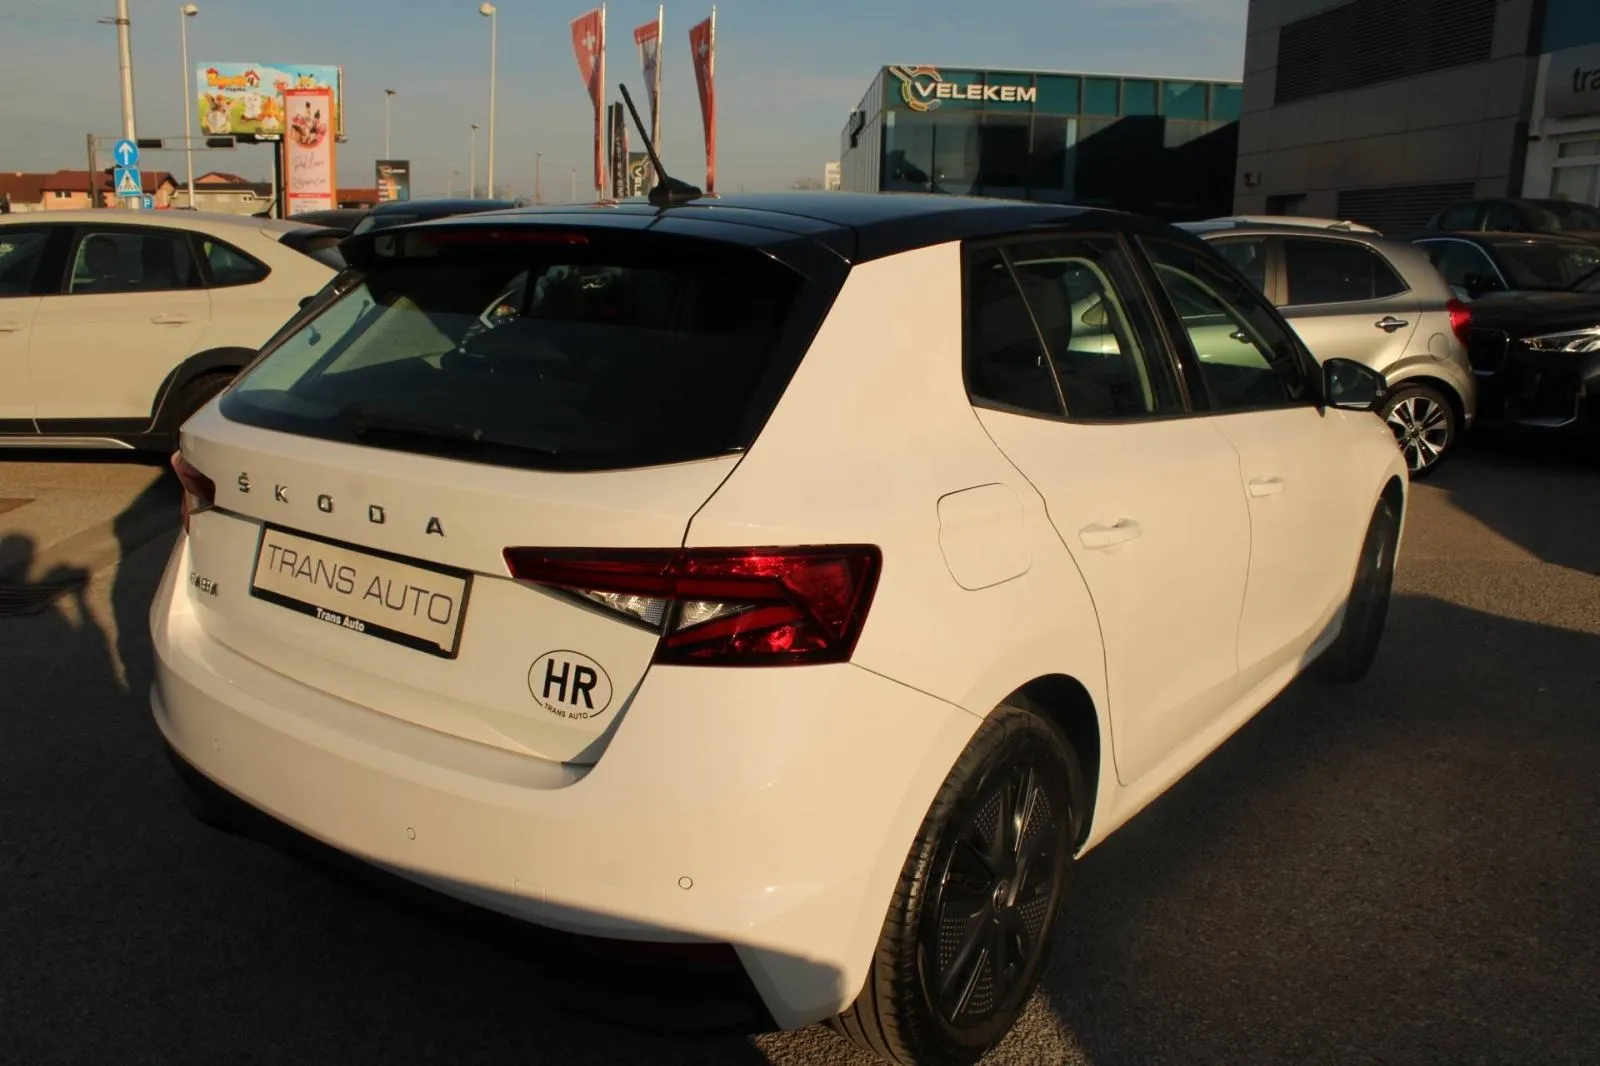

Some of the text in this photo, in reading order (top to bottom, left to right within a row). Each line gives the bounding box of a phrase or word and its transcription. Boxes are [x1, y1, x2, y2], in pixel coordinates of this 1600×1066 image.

[914, 81, 1037, 103] VELEKEM
[237, 471, 445, 537] ŠKODA
[268, 543, 454, 626] TRANS AUTO
[316, 607, 365, 632] Trans Auto
[542, 658, 598, 710] HR
[544, 702, 589, 721] TRANS AUTO
